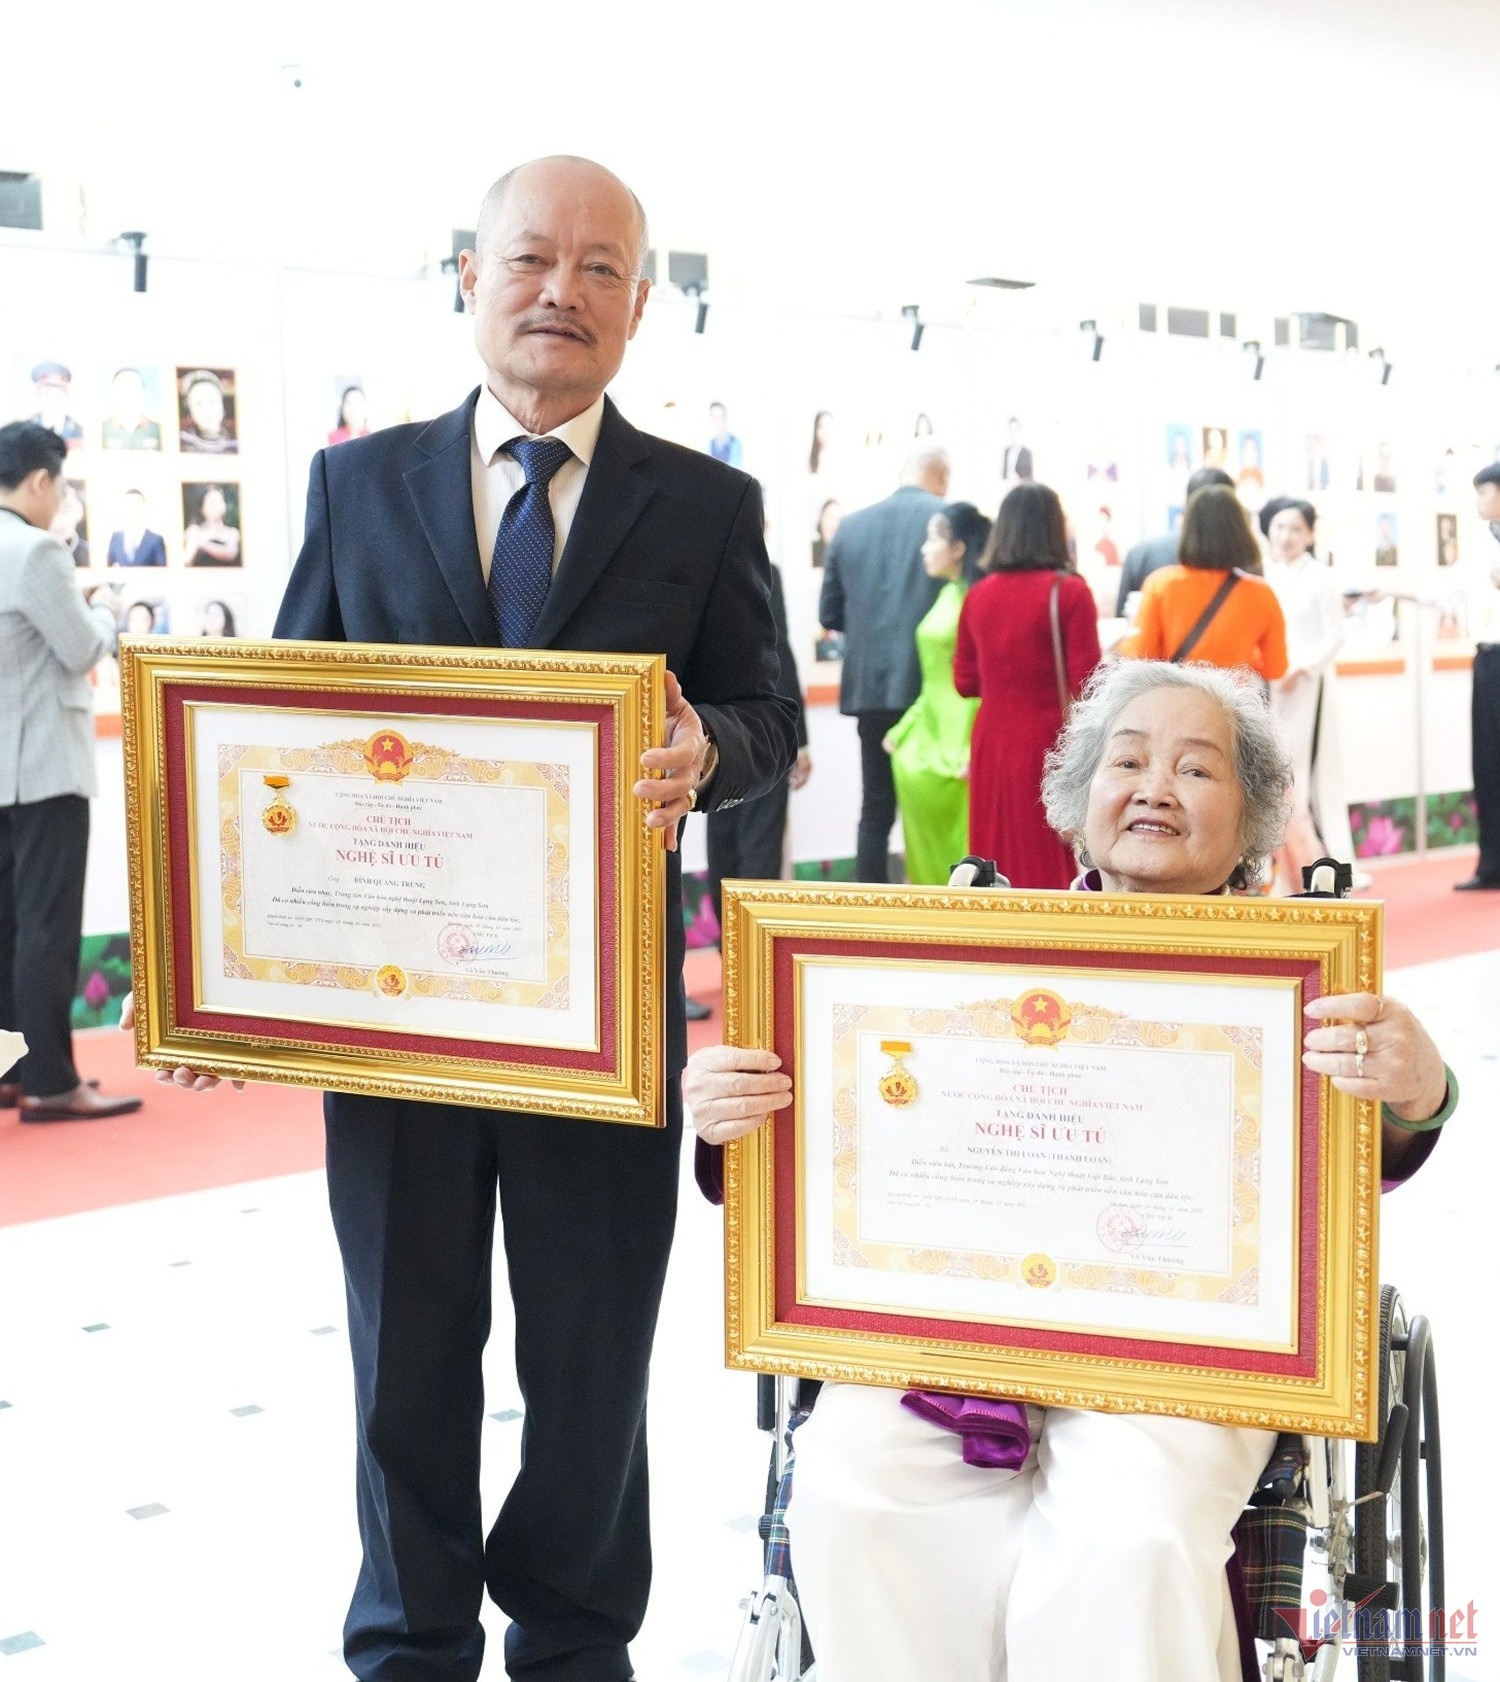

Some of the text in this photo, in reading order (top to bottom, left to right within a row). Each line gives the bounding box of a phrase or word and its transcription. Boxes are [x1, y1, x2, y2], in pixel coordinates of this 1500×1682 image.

[336, 848, 444, 869] NGHỆ SĨ ƯU TÚ
[401, 881, 426, 889] TRUNG
[1122, 1103, 1144, 1112] NAM
[975, 1121, 1107, 1145] NGHỆ SĨ ƯU TÚ
[1022, 1150, 1046, 1159] LOAN
[984, 1164, 999, 1172] Cao
